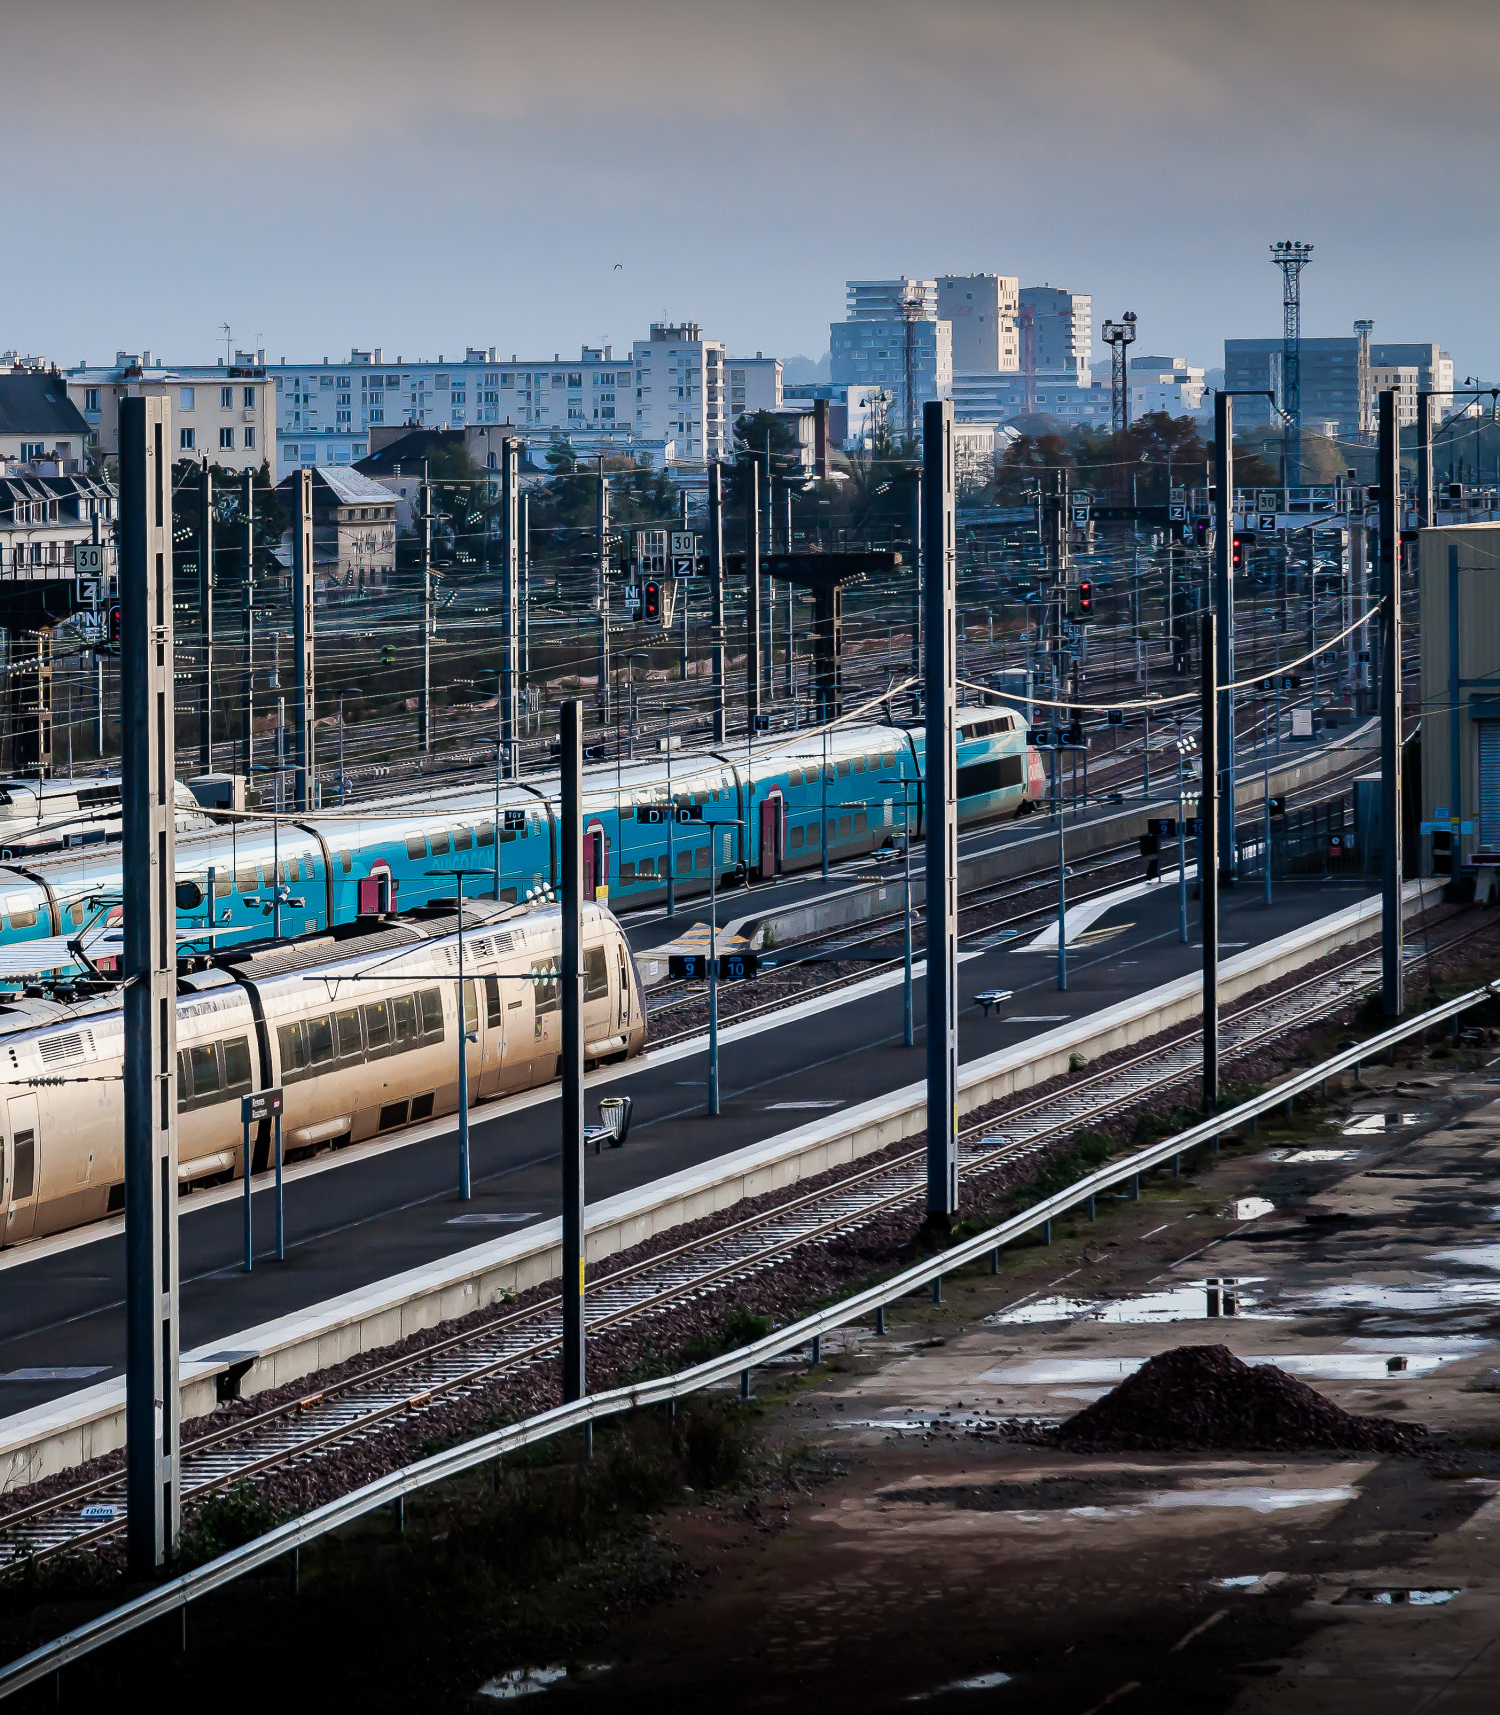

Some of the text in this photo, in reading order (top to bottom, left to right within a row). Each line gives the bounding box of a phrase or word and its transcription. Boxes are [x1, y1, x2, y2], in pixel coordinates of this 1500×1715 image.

[1260, 496, 1275, 508] 30
[1076, 510, 1085, 519] Z
[1173, 508, 1182, 517] Z
[1262, 517, 1273, 528] Z
[674, 536, 691, 550] 30
[80, 551, 98, 566] 30
[678, 560, 690, 574] Z
[83, 582, 98, 597] Z
[625, 586, 639, 598] Nr
[1036, 734, 1045, 744] C
[1061, 733, 1070, 744] C
[508, 811, 522, 819] TGV
[650, 810, 660, 822] D
[680, 810, 691, 822] D
[1160, 824, 1168, 835] 9
[686, 963, 694, 975] 9
[728, 963, 744, 975] 10
